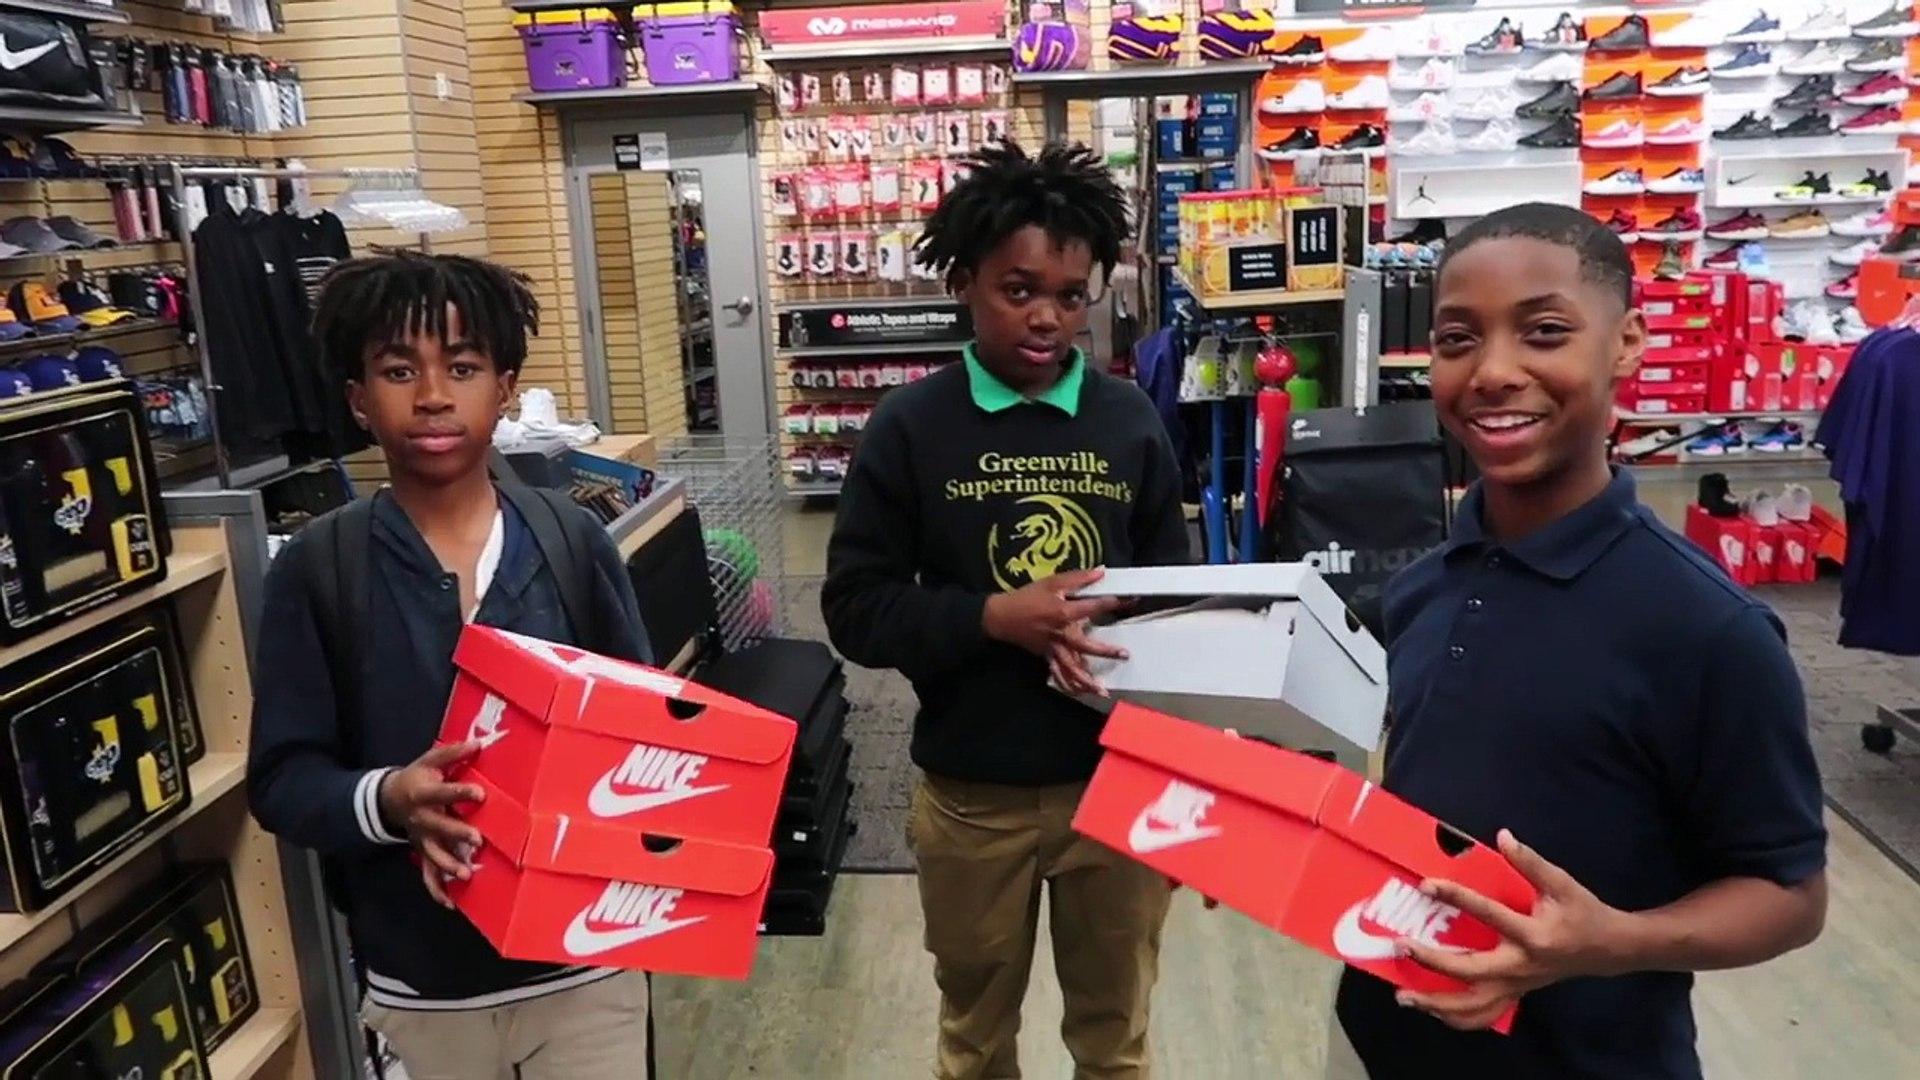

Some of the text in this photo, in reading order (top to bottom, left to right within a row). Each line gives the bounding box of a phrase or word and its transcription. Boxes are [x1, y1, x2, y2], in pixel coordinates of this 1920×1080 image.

[847, 311, 957, 326] Athletic Tapes and Wraps
[978, 451, 1109, 474] Greenville
[945, 474, 1133, 503] Superintendent's
[612, 742, 708, 791] NIKE
[592, 878, 684, 928] NIKE
[1362, 874, 1462, 946] NIKE
